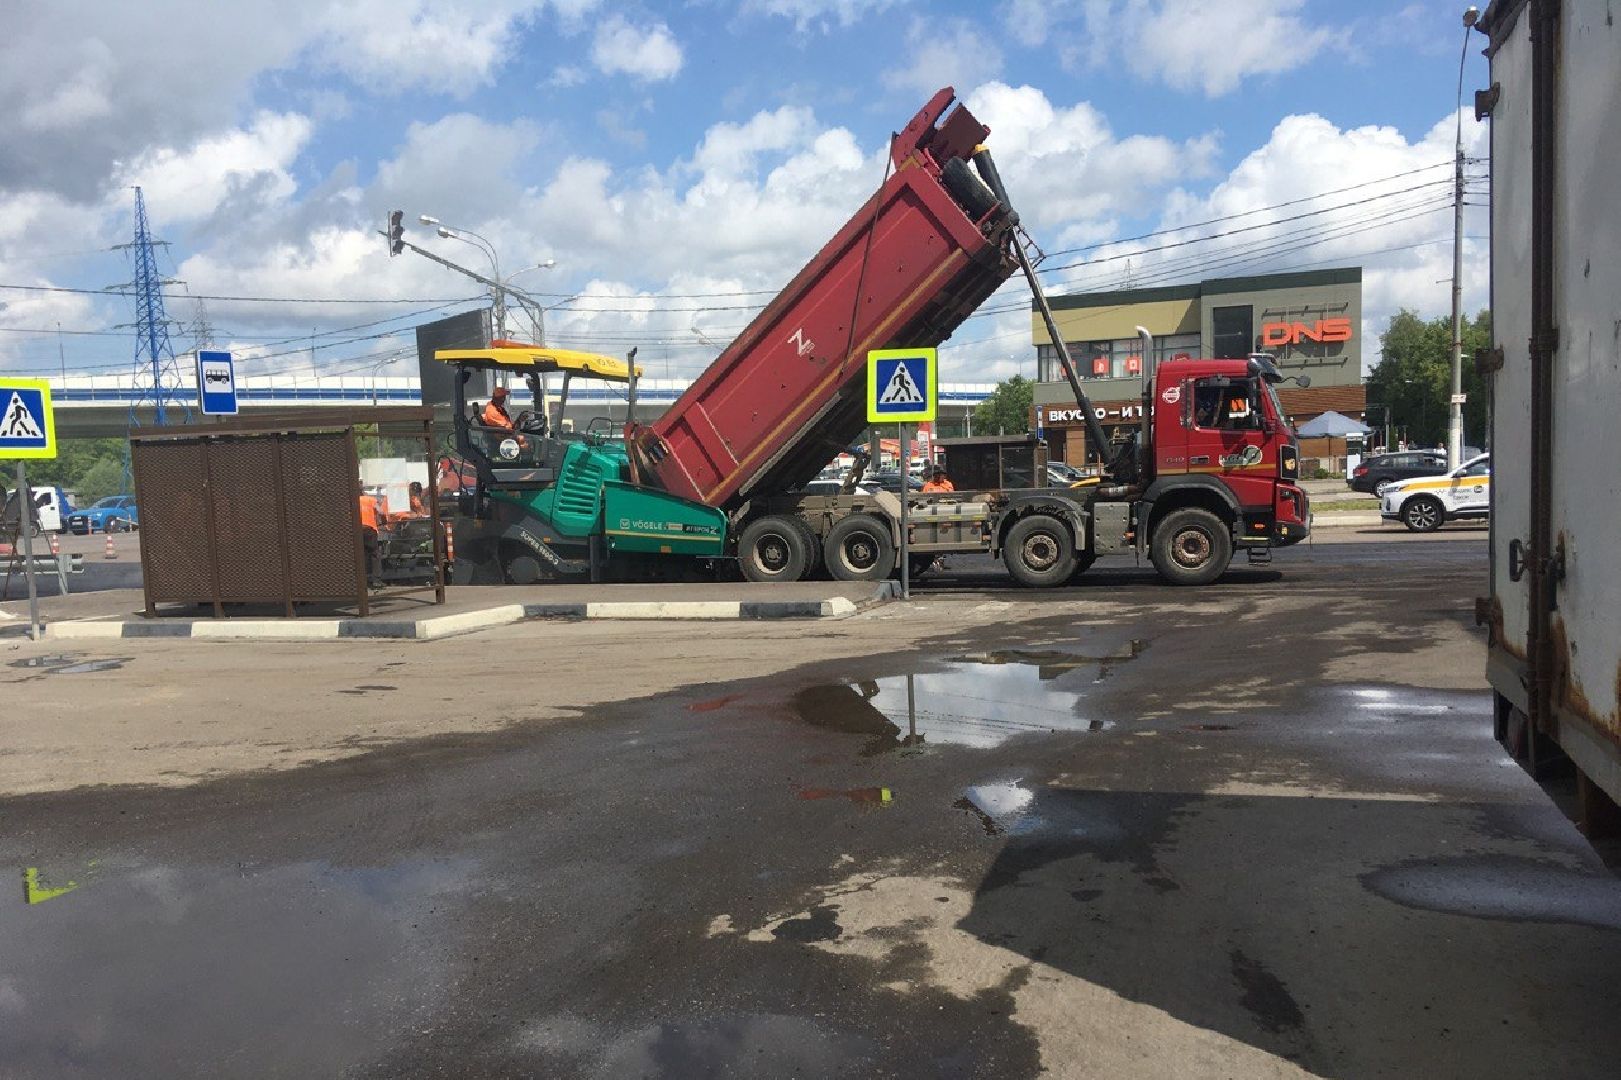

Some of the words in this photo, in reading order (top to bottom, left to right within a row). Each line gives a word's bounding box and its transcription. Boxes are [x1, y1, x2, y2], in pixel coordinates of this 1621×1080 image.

[1263, 317, 1352, 345] DNS
[1049, 407, 1106, 422] ВКУСО
[632, 520, 662, 530] VÖGELE
